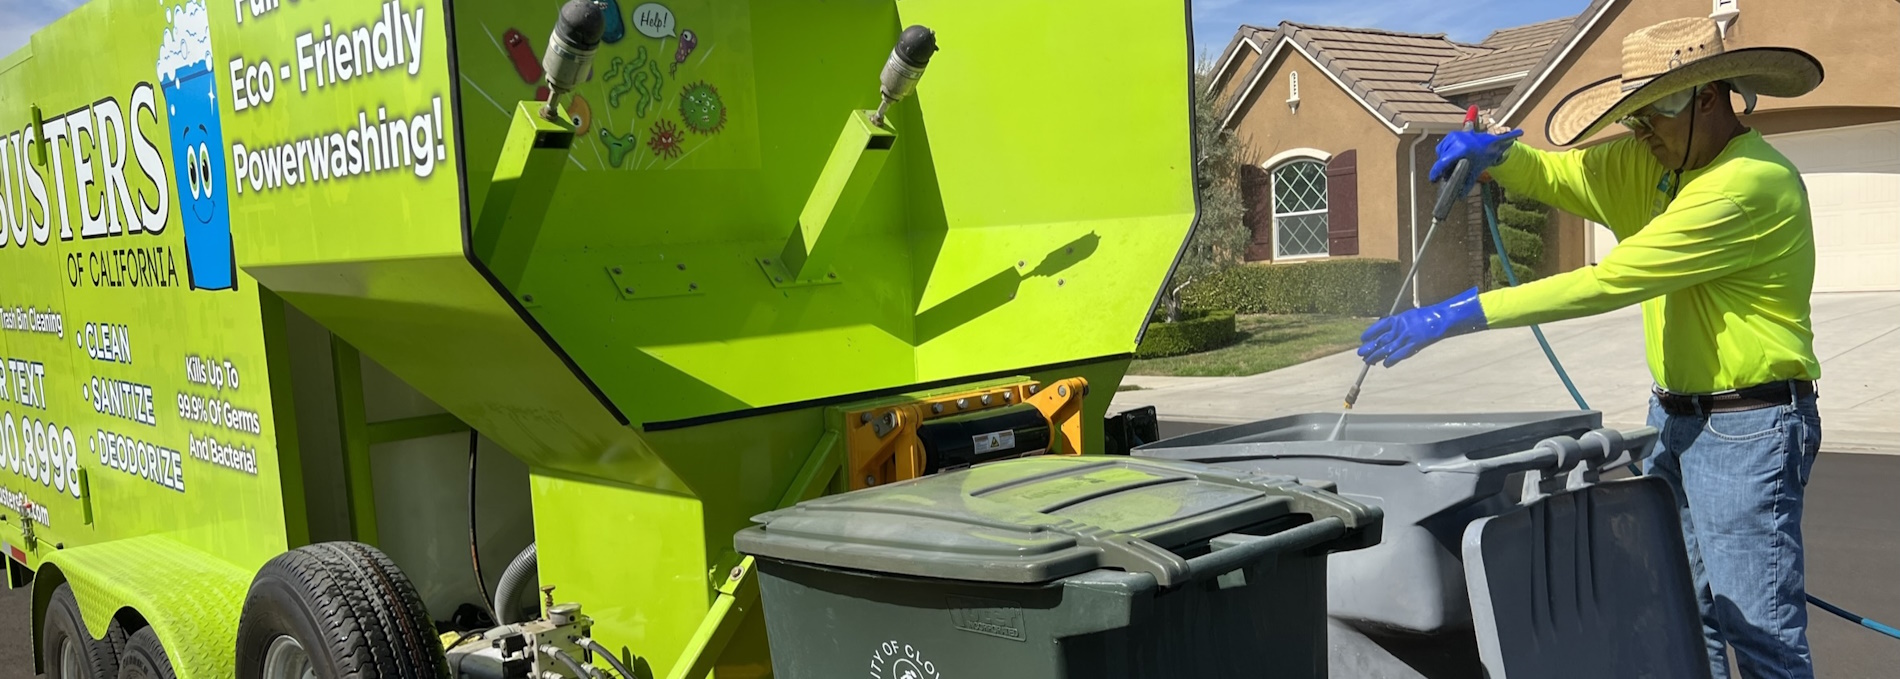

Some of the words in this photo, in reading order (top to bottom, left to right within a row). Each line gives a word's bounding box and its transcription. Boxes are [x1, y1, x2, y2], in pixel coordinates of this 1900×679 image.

[640, 10, 668, 33] Help!
[229, 58, 275, 111] Eco
[295, 0, 424, 92] Friendly
[0, 81, 169, 249] USTERS
[232, 96, 446, 194] Powerwashing!
[67, 251, 84, 287] OF
[89, 246, 180, 287] CALIFORNIA
[16, 307, 29, 330] Bin
[29, 307, 64, 338] Cleaning
[85, 322, 132, 364] CLEAN
[8, 358, 46, 410] TEXT
[185, 356, 207, 384] Kills
[207, 359, 224, 391] Up
[223, 361, 239, 389] To
[91, 375, 156, 426] SANITIZE
[177, 393, 208, 423] 99.9%
[208, 399, 222, 426] Of
[223, 402, 261, 434] Germs
[97, 429, 186, 492] DEODORIZE
[189, 433, 210, 461] And
[209, 438, 258, 474] Bacteria!
[882, 640, 900, 656] OF
